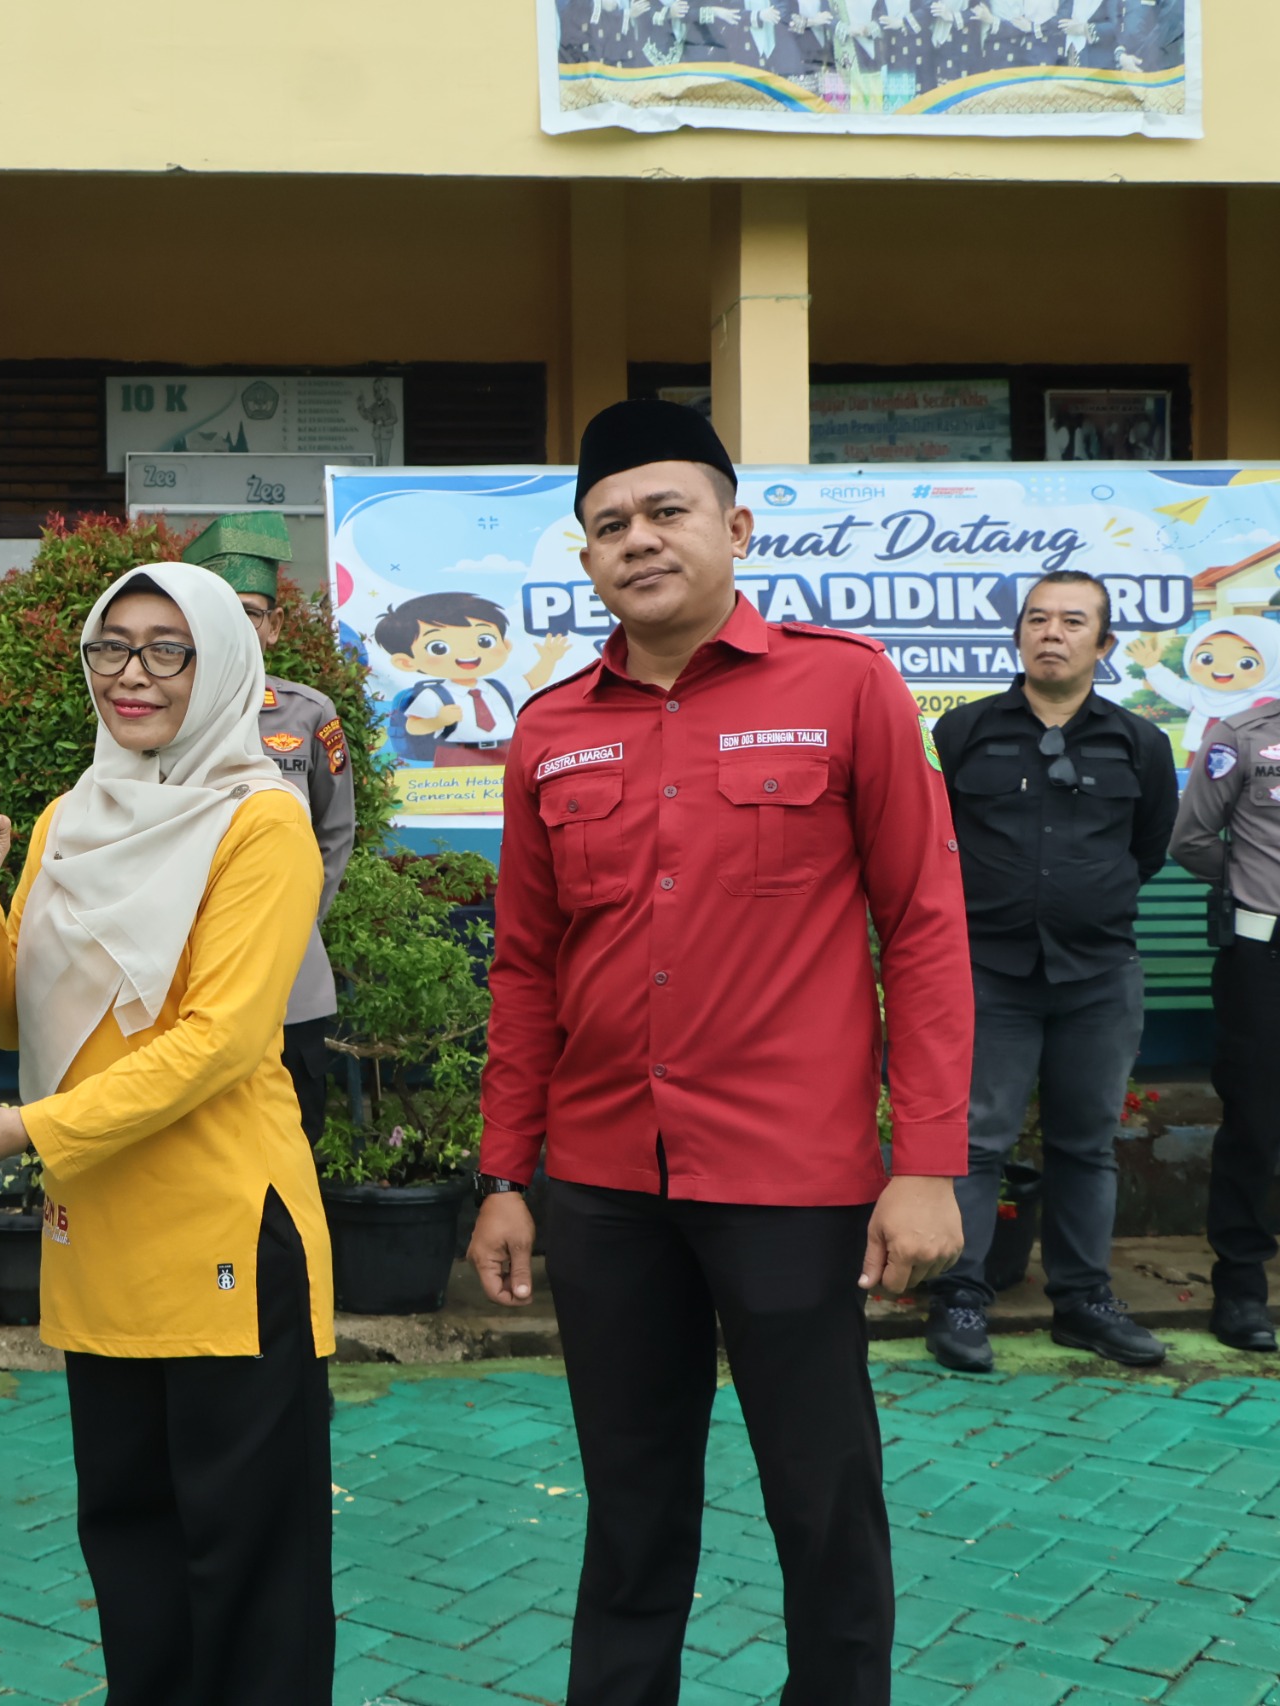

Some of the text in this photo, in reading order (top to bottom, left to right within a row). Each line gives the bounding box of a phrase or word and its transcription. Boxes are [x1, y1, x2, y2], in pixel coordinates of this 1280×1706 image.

[165, 384, 188, 412] K
[143, 465, 176, 487] Zee
[246, 476, 286, 503] Zee
[820, 487, 886, 499] RAMAH
[874, 510, 1088, 570] Datang
[828, 576, 1001, 621] DIDIK
[723, 731, 823, 747] SDN 003 BERINGIN TALUK
[544, 747, 614, 773] SASTRA MARGA
[408, 777, 459, 789] Sekolah
[406, 791, 476, 802] Generasi
